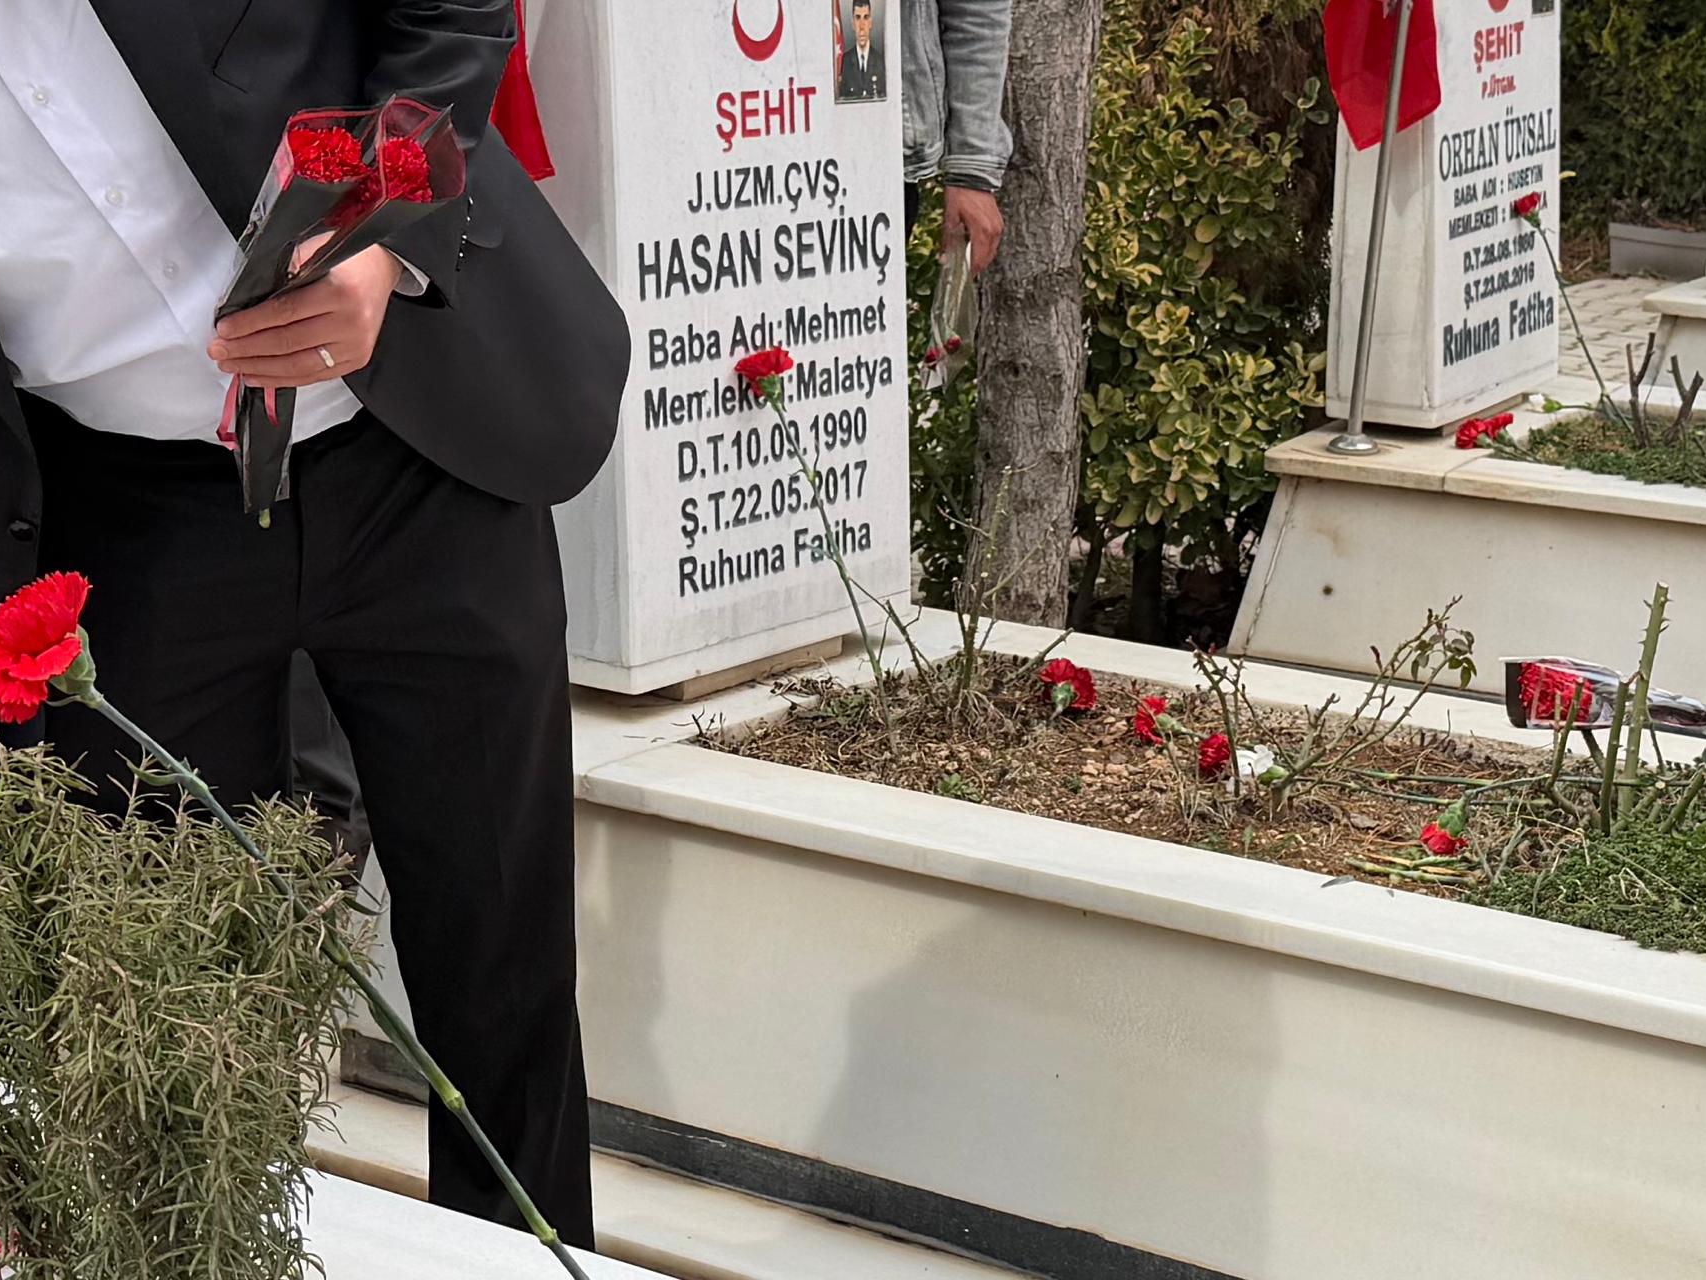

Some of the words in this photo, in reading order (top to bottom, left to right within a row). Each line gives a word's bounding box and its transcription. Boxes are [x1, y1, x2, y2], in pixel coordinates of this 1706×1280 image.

[715, 77, 817, 152] ŞEHİT
[1439, 121, 1500, 182] ORHAN
[1504, 106, 1557, 164] ÜNSAL
[688, 158, 848, 215] J.UZM.ÇVŞ.
[1453, 182, 1478, 208] BABA
[637, 228, 763, 303] HASAN
[774, 206, 892, 286] SEVİNÇ
[649, 324, 721, 371] Baba
[1443, 317, 1500, 368] Ruhuna
[1509, 291, 1555, 341] Fatiha
[679, 543, 785, 597] Ruhuna
